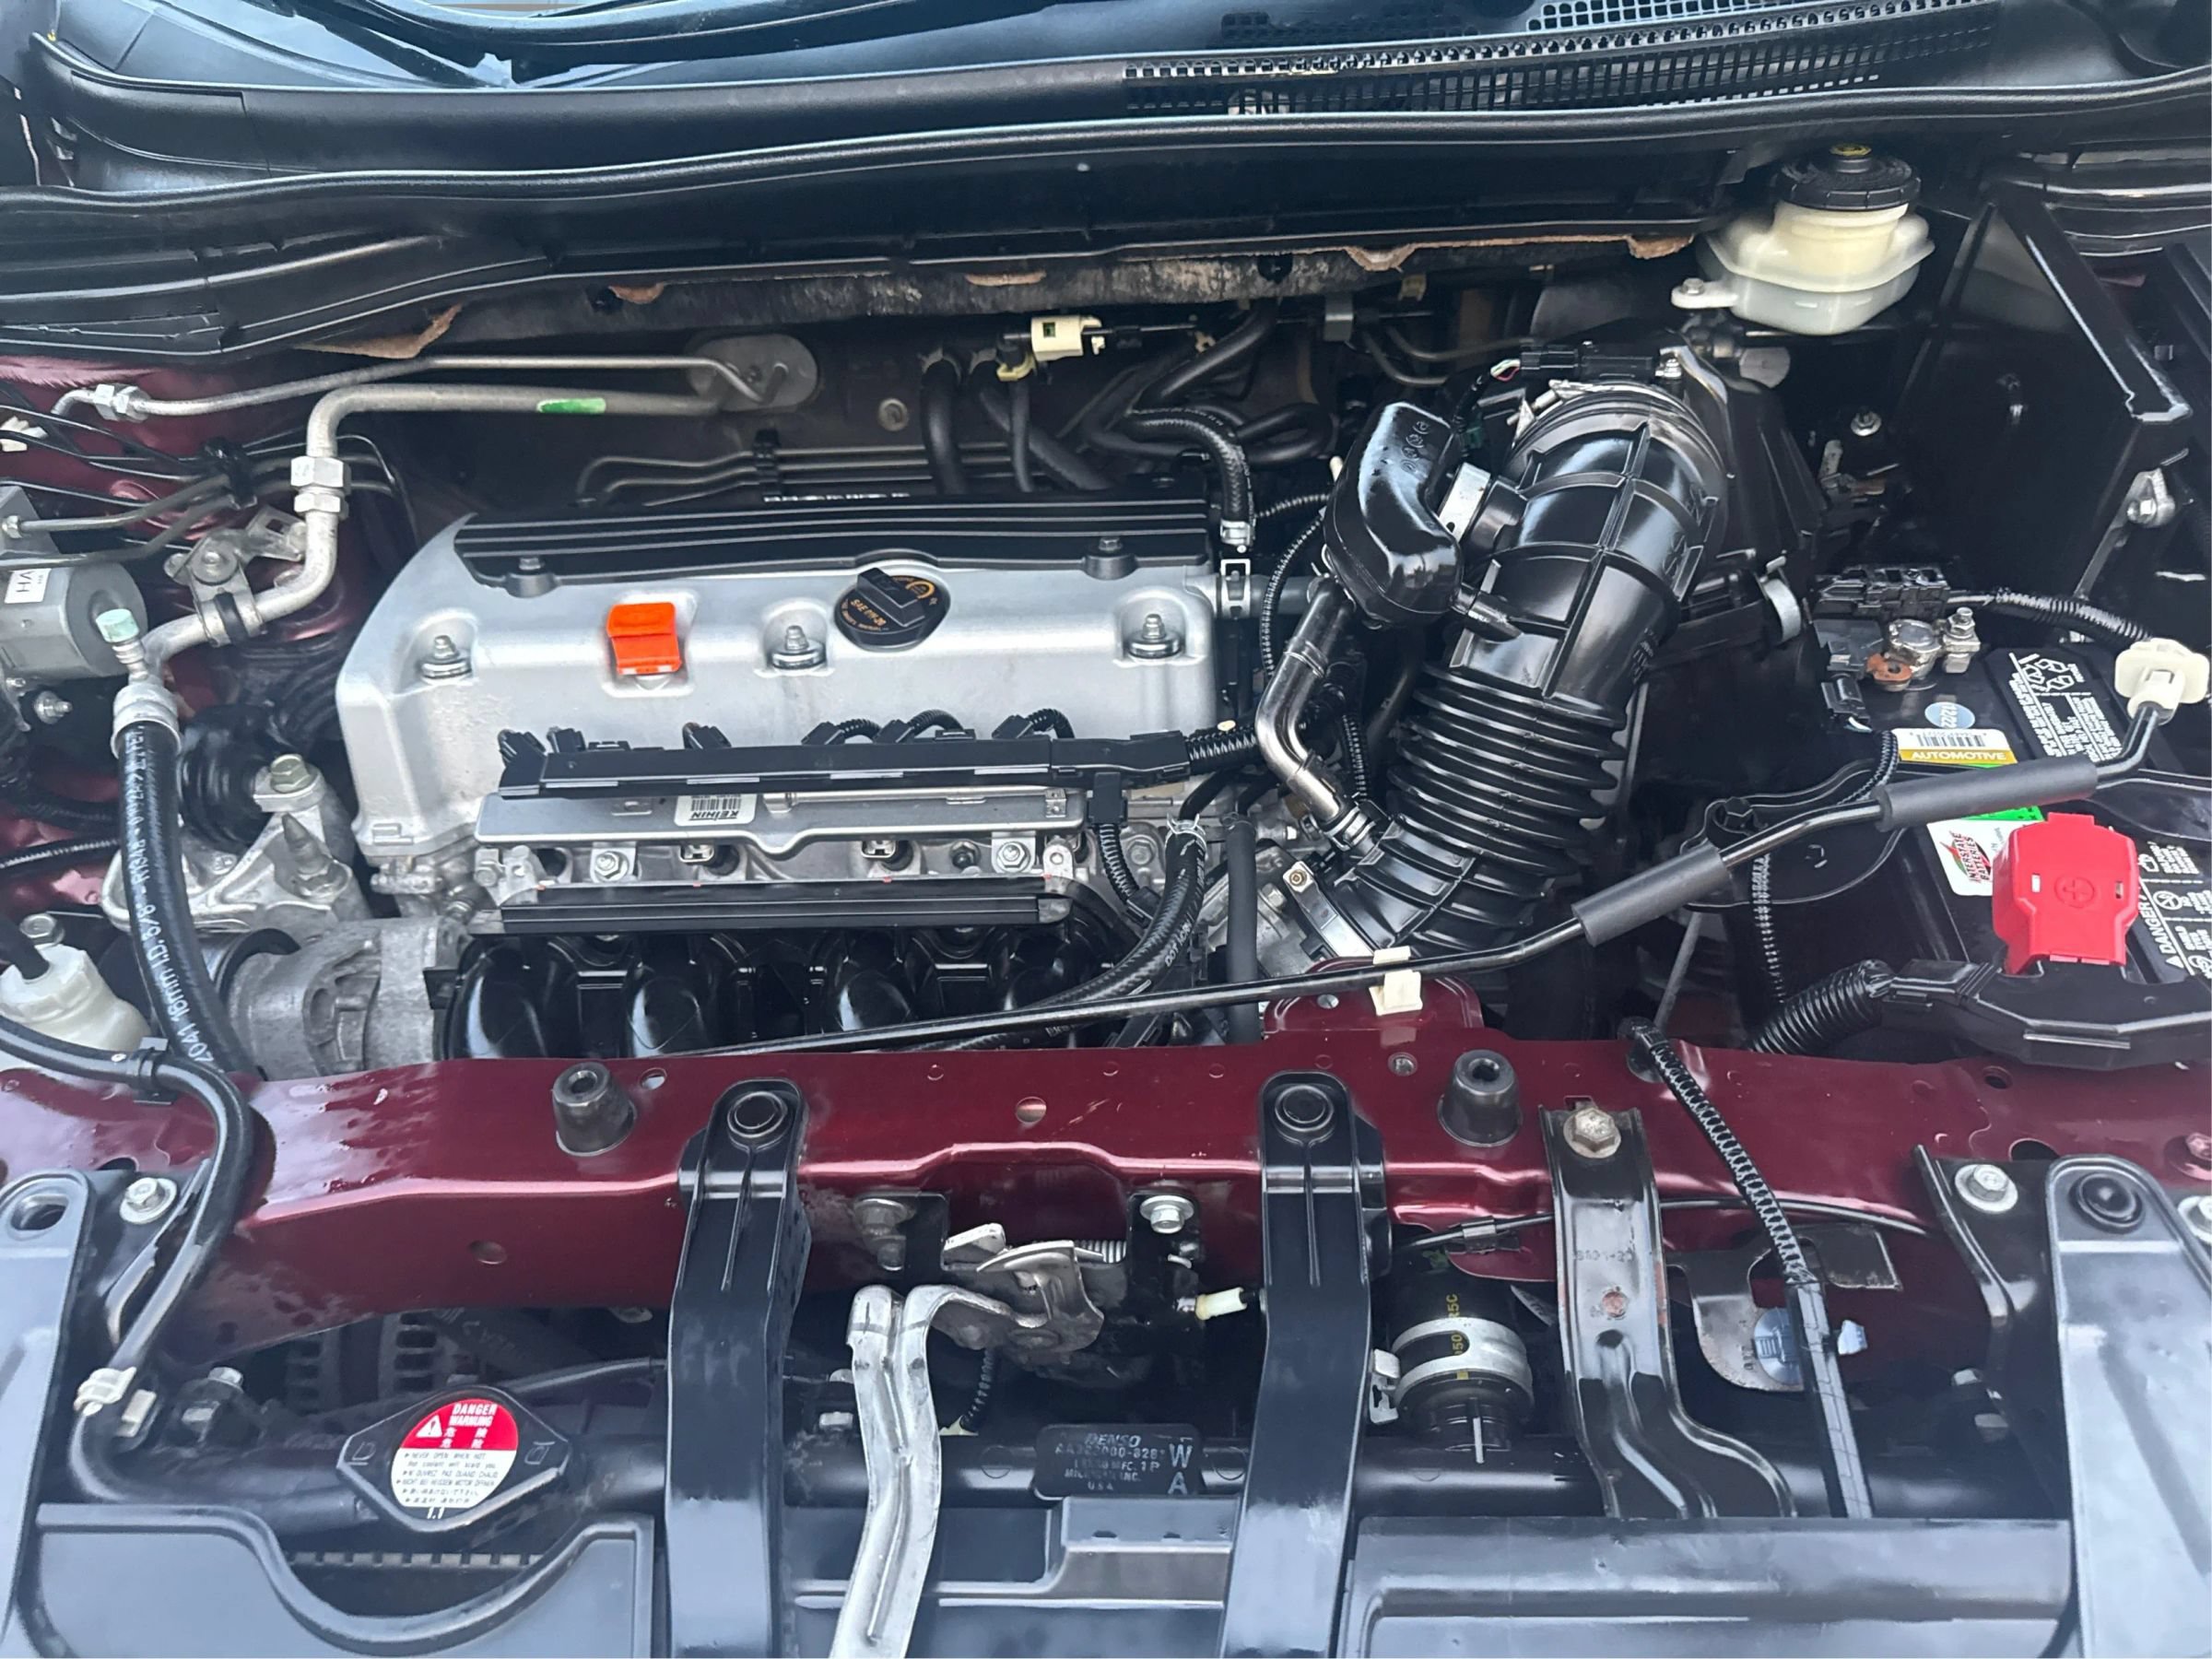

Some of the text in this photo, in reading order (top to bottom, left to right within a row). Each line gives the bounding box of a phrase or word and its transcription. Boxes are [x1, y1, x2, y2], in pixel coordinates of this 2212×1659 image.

[1912, 751, 2006, 760] AUTOMOTIVE
[1953, 832, 1982, 883] INTERSTATE
[1963, 836, 1991, 881] BATTERIES
[159, 968, 191, 1021] 16mm
[453, 1403, 498, 1416] DANGER
[448, 1416, 494, 1427] WARNING
[1084, 1433, 1142, 1448] DENSO
[1169, 1443, 1193, 1468] W
[1167, 1472, 1188, 1495] A
[427, 1507, 445, 1519] 1.1
